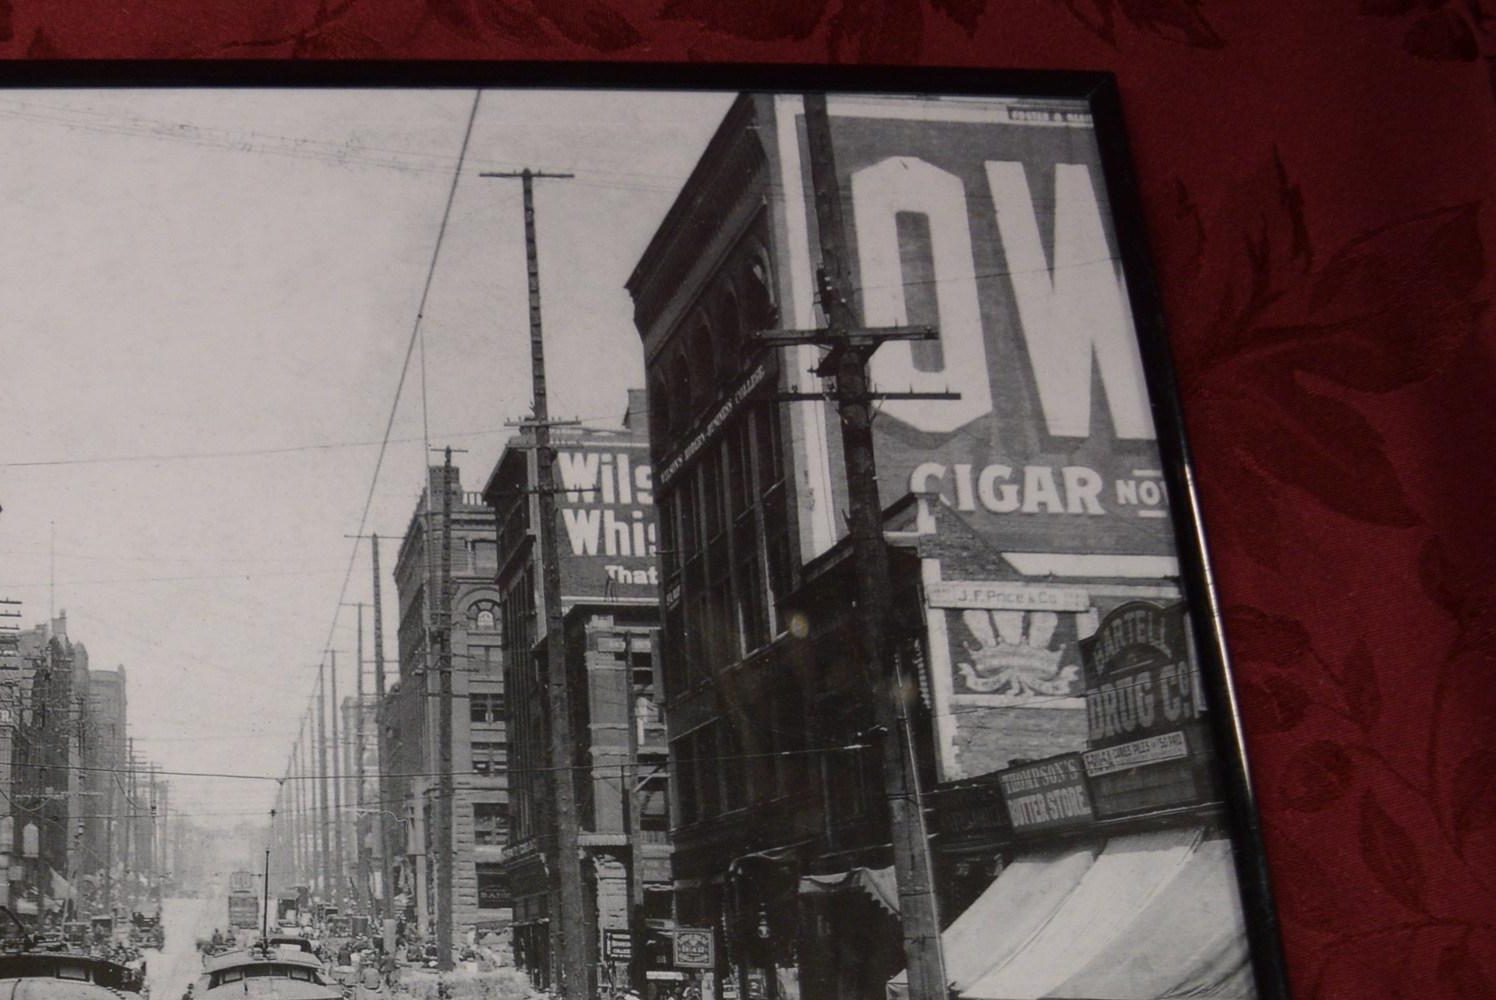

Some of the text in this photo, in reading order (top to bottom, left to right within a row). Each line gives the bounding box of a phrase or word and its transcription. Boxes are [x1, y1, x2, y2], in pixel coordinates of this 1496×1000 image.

[558, 452, 654, 504] Wils
[910, 462, 1170, 515] CIGAR NO
[605, 565, 658, 584] That
[1087, 671, 1155, 740] DRUG
[1002, 759, 1079, 794] THOMPSON'S
[1007, 792, 1049, 828] BUTTER
